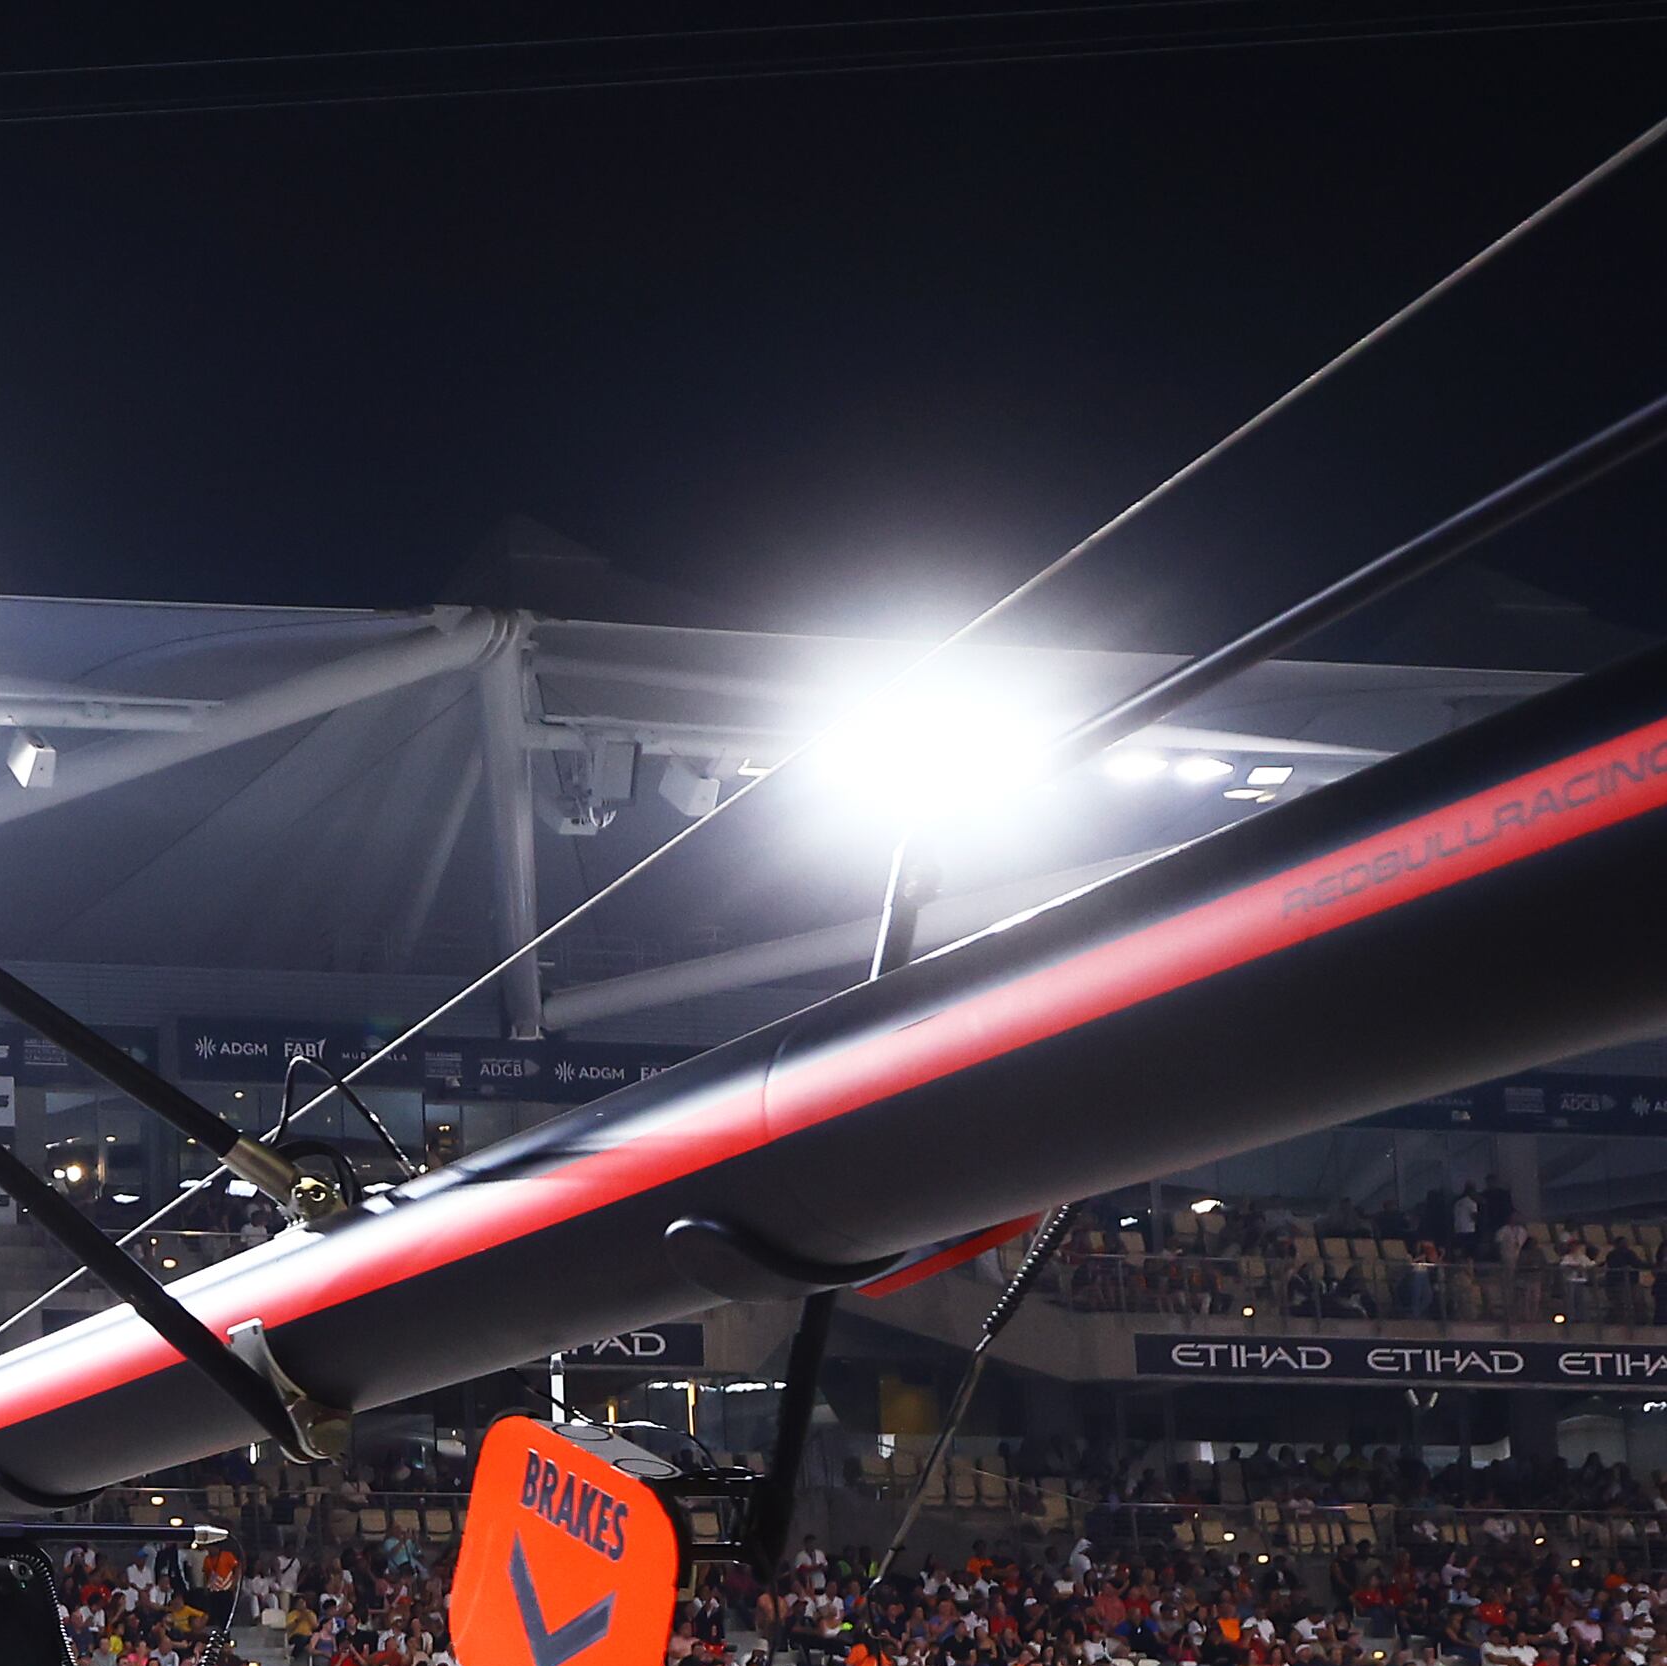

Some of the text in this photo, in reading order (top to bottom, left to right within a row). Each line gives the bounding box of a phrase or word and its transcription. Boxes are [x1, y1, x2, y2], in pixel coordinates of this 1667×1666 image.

[220, 1042, 268, 1057] ADGM
[284, 1042, 317, 1058] FAB
[342, 1051, 408, 1062] MUBALA
[480, 1064, 523, 1077] ADCB
[578, 1067, 626, 1080] ADGM
[1171, 1344, 1333, 1370] ETIHAD
[1366, 1348, 1525, 1374] ETIHAD
[520, 1448, 628, 1562] BRAKES
